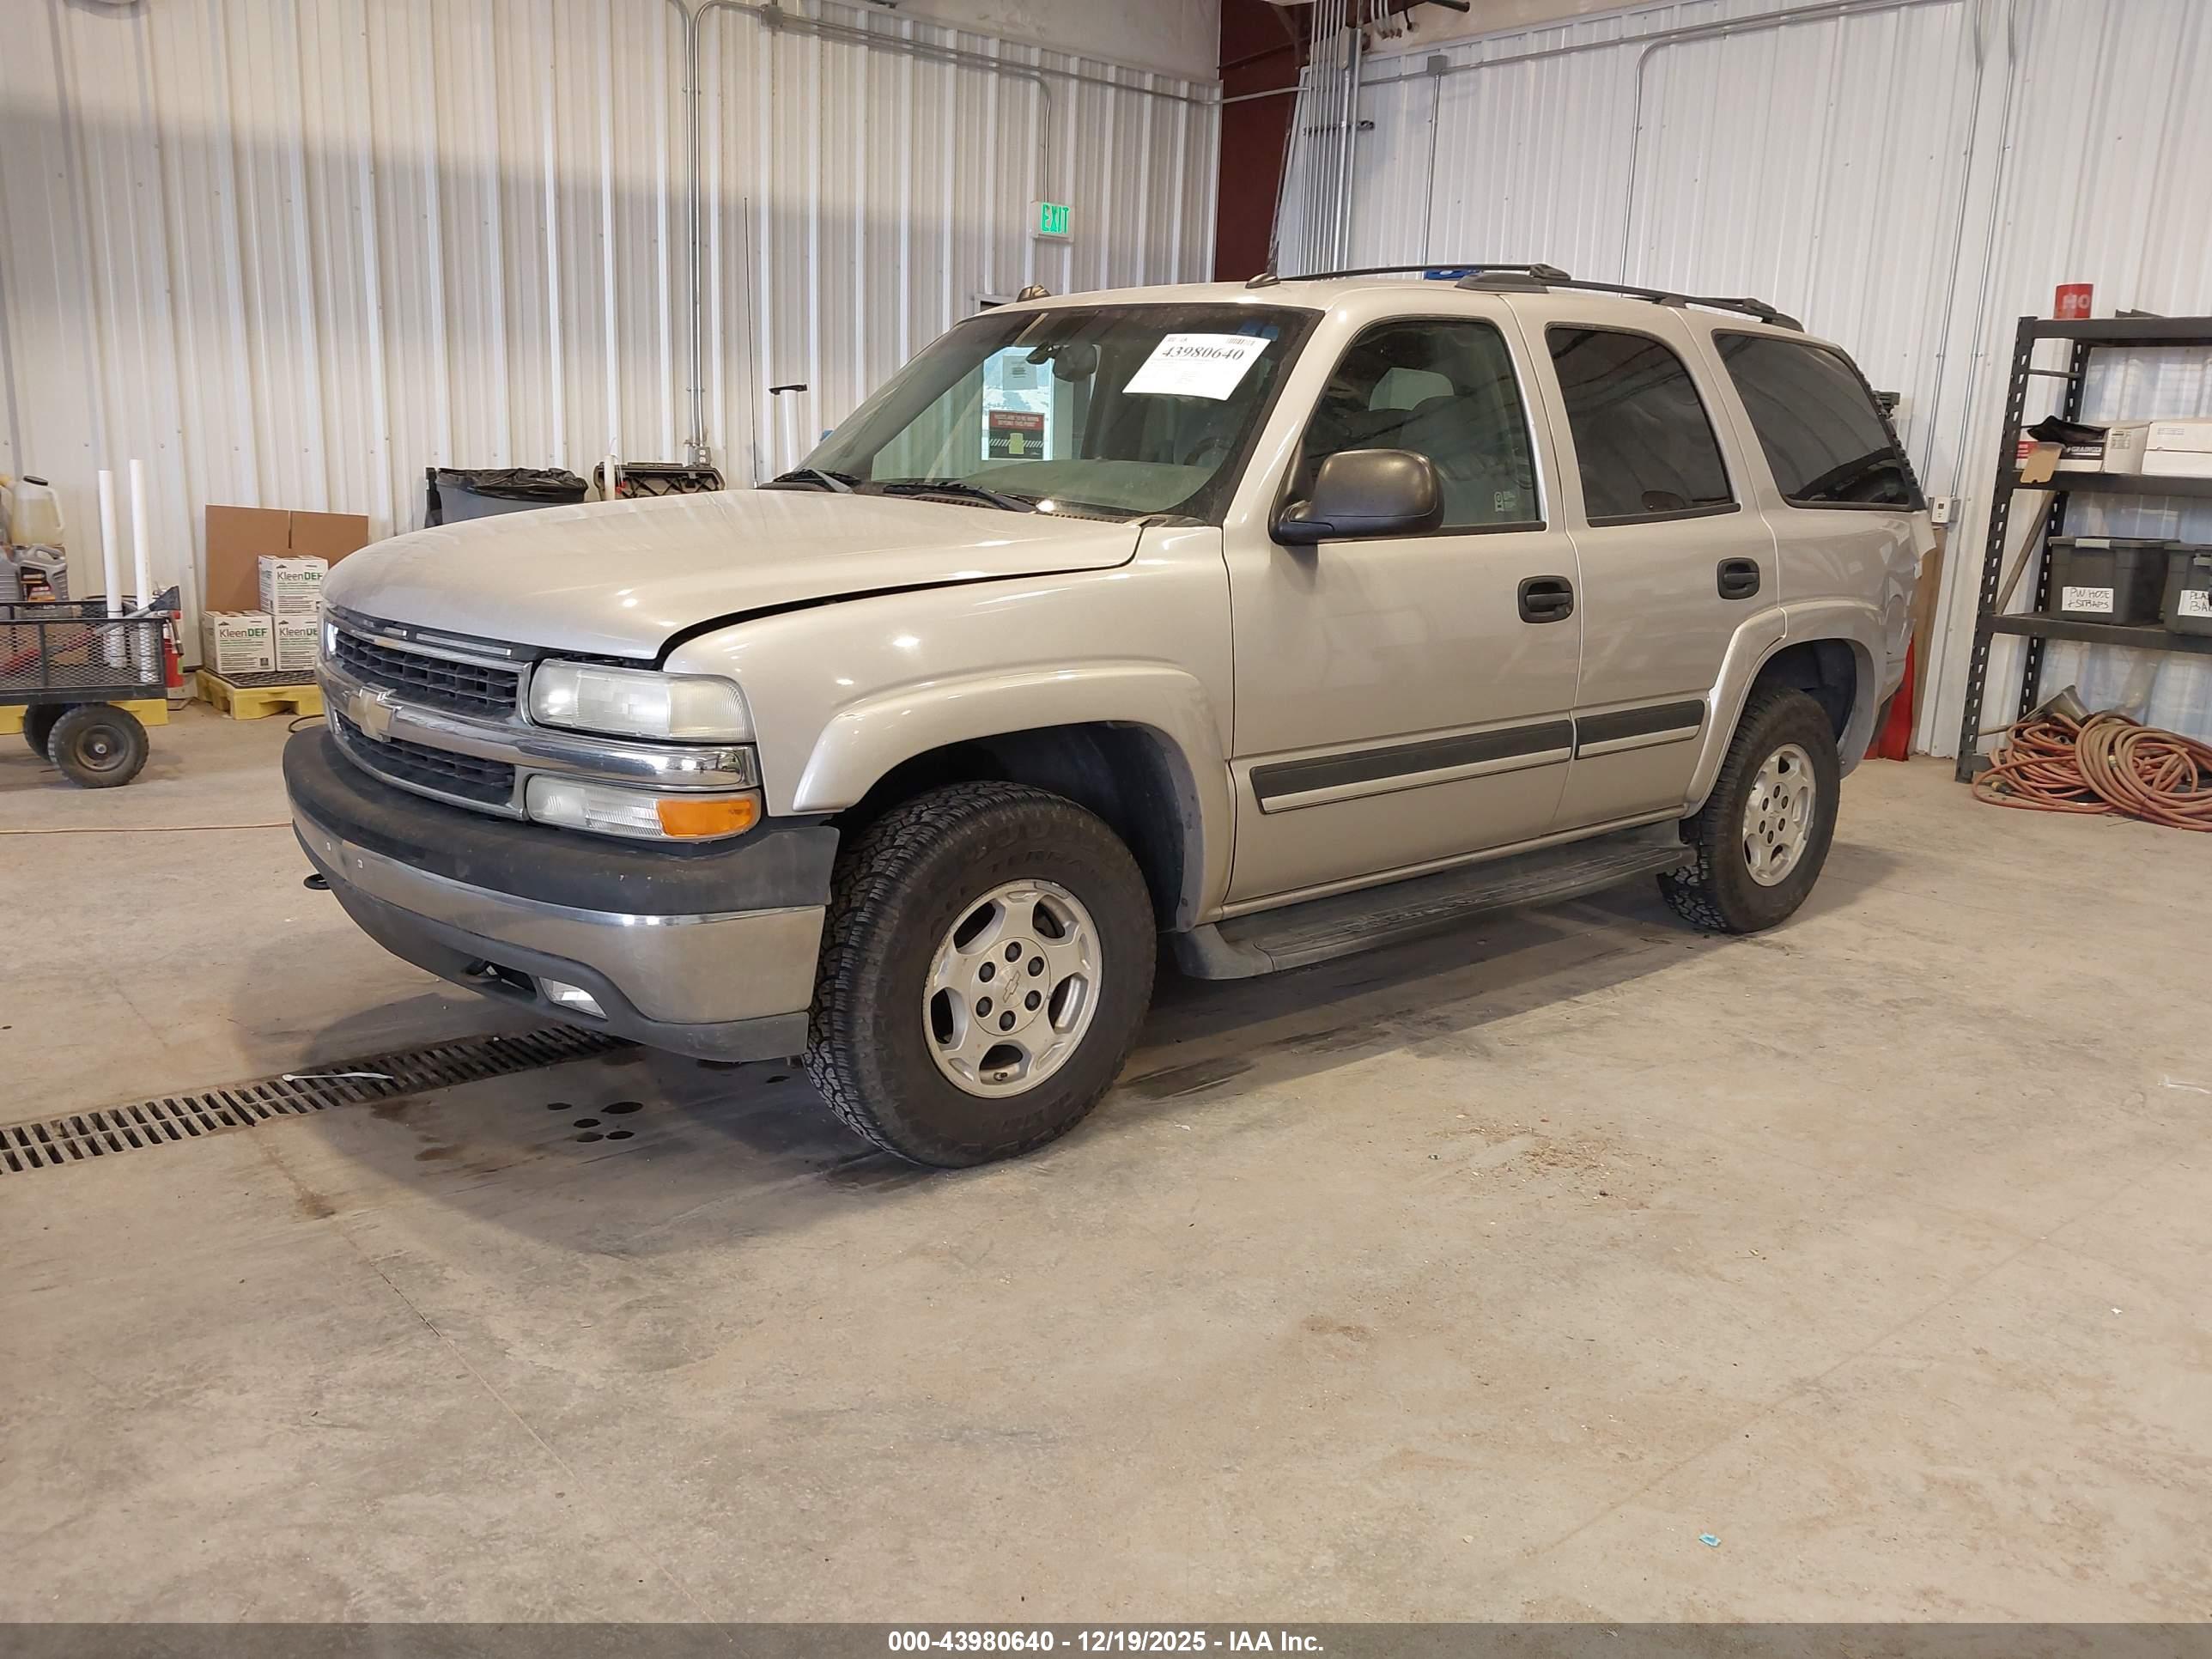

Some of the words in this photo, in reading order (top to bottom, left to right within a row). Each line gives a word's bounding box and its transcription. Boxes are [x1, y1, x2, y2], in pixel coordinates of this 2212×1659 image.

[1042, 203, 1069, 234] EXIT
[1163, 346, 1244, 361] 43980640
[276, 571, 323, 580] KleenDEF
[219, 628, 268, 638] KleenDEF
